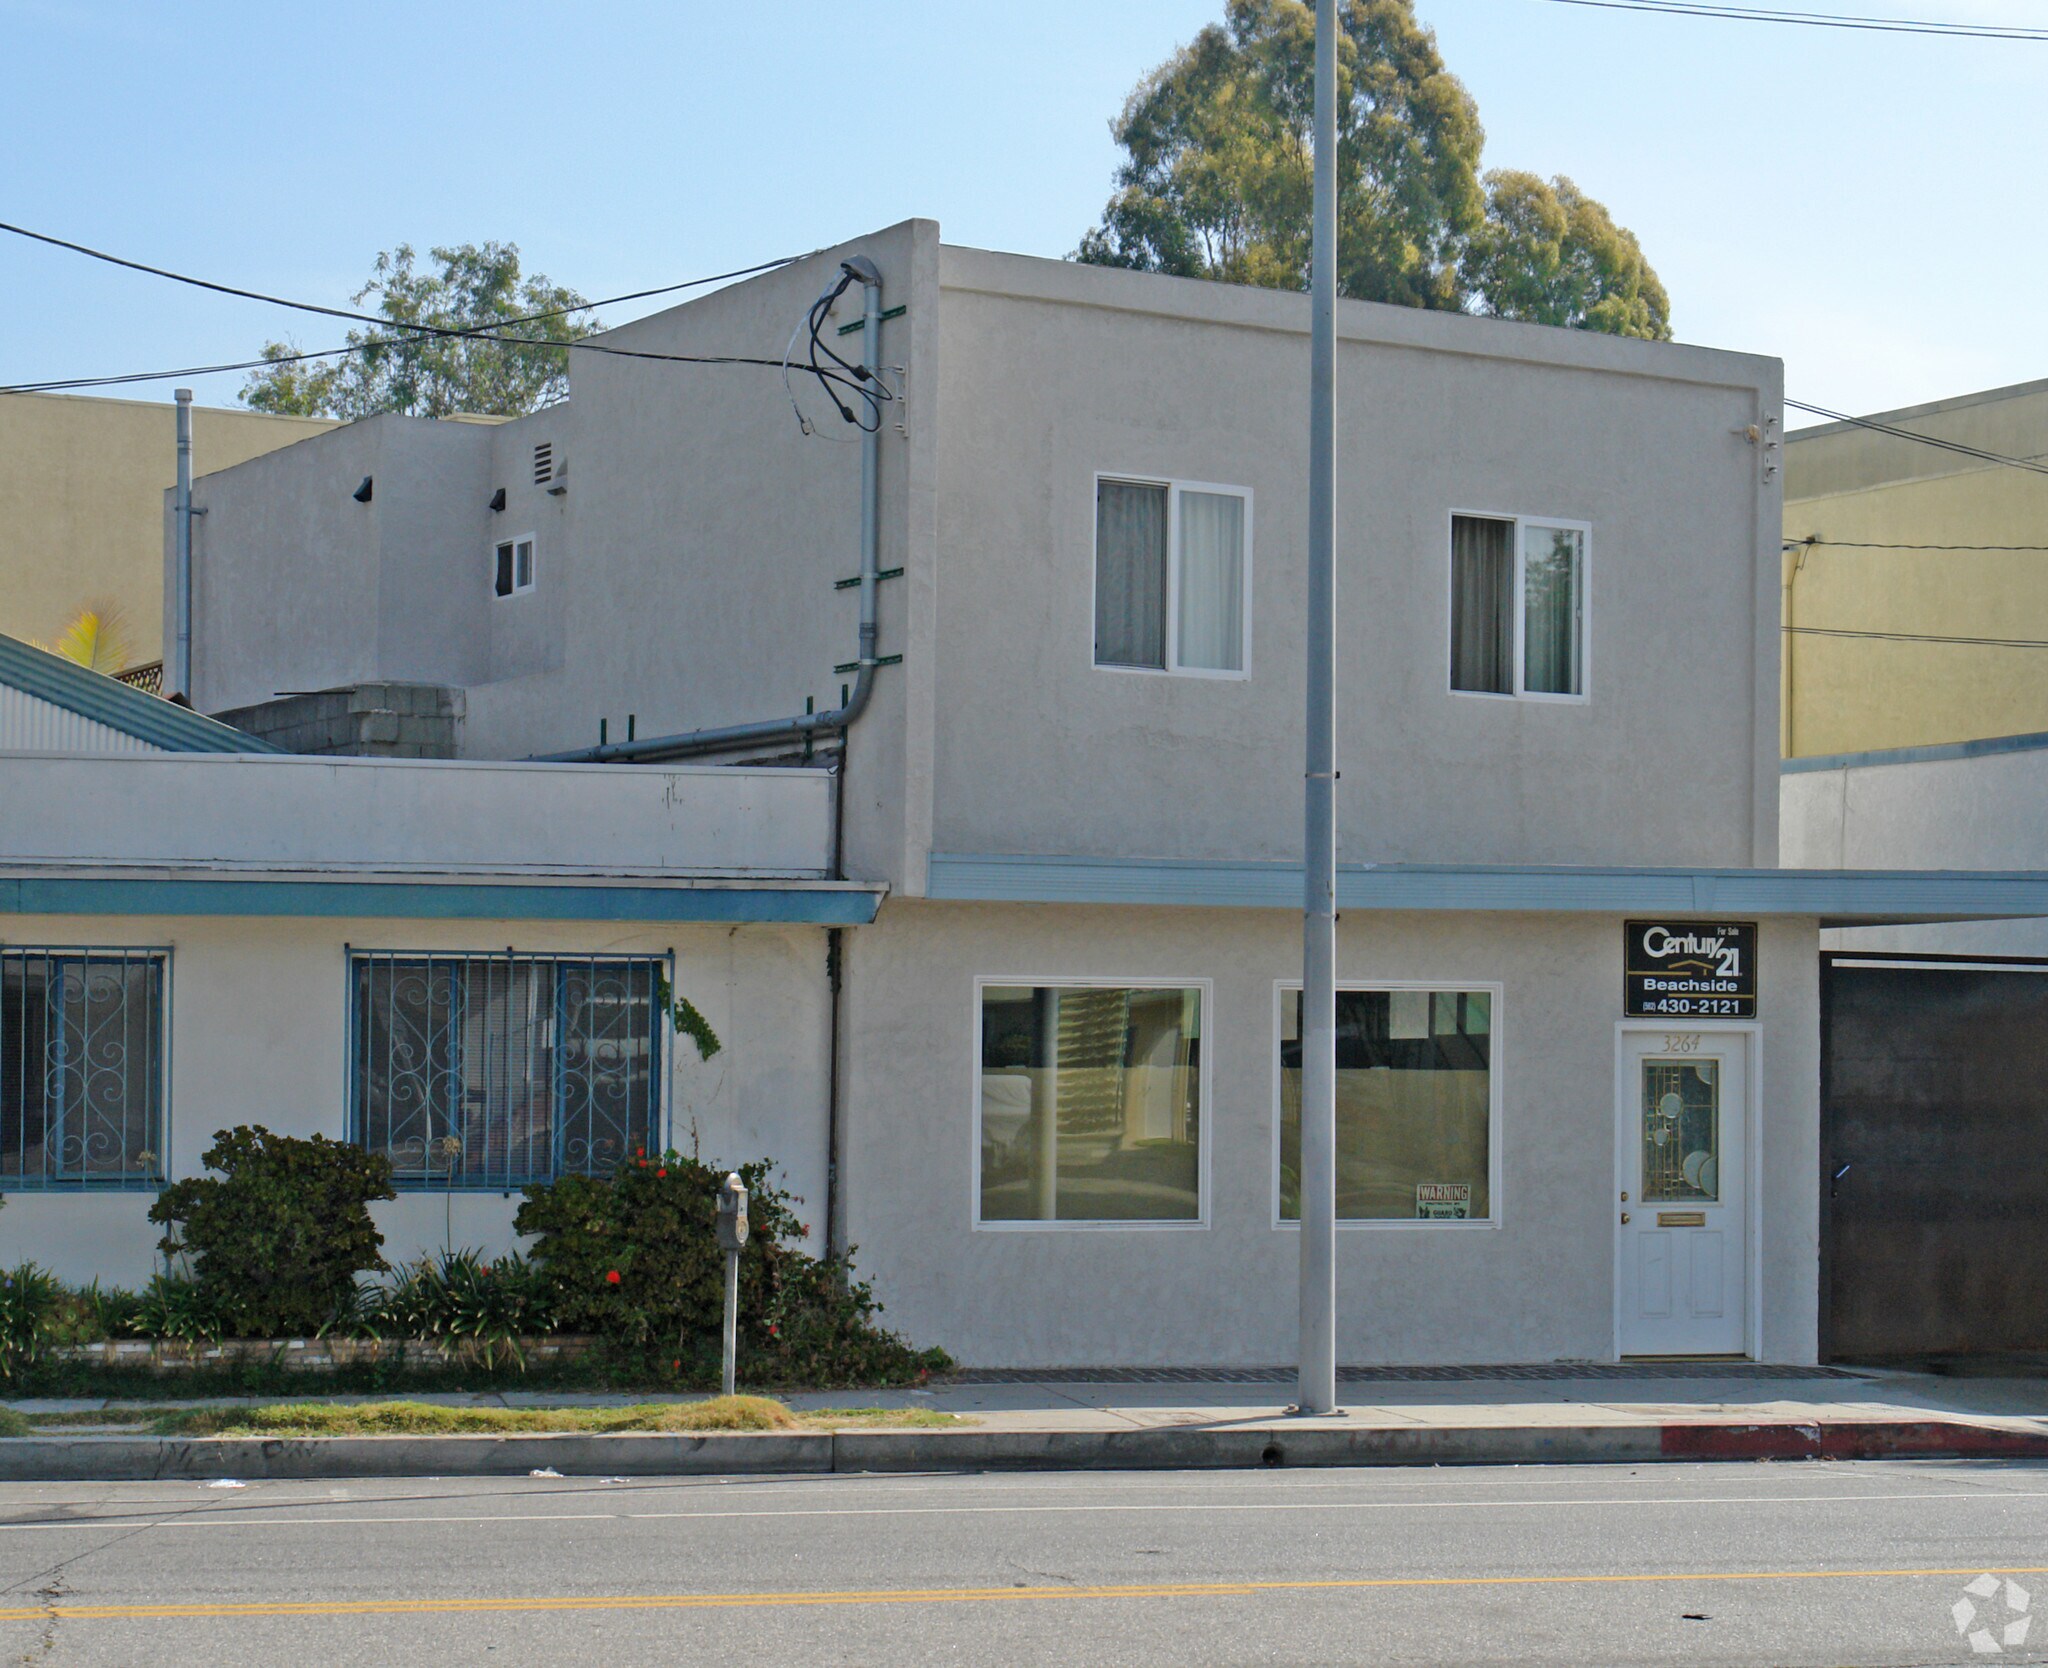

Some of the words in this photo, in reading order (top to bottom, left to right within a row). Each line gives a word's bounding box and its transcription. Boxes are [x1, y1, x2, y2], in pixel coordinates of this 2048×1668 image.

[1643, 926, 1724, 958] Century
[1715, 947, 1740, 977] 21
[1643, 978, 1738, 992] Beachside
[1657, 999, 1739, 1014] 430-2121
[1662, 1034, 1700, 1053] 3264
[1420, 1186, 1468, 1200] WARNING
